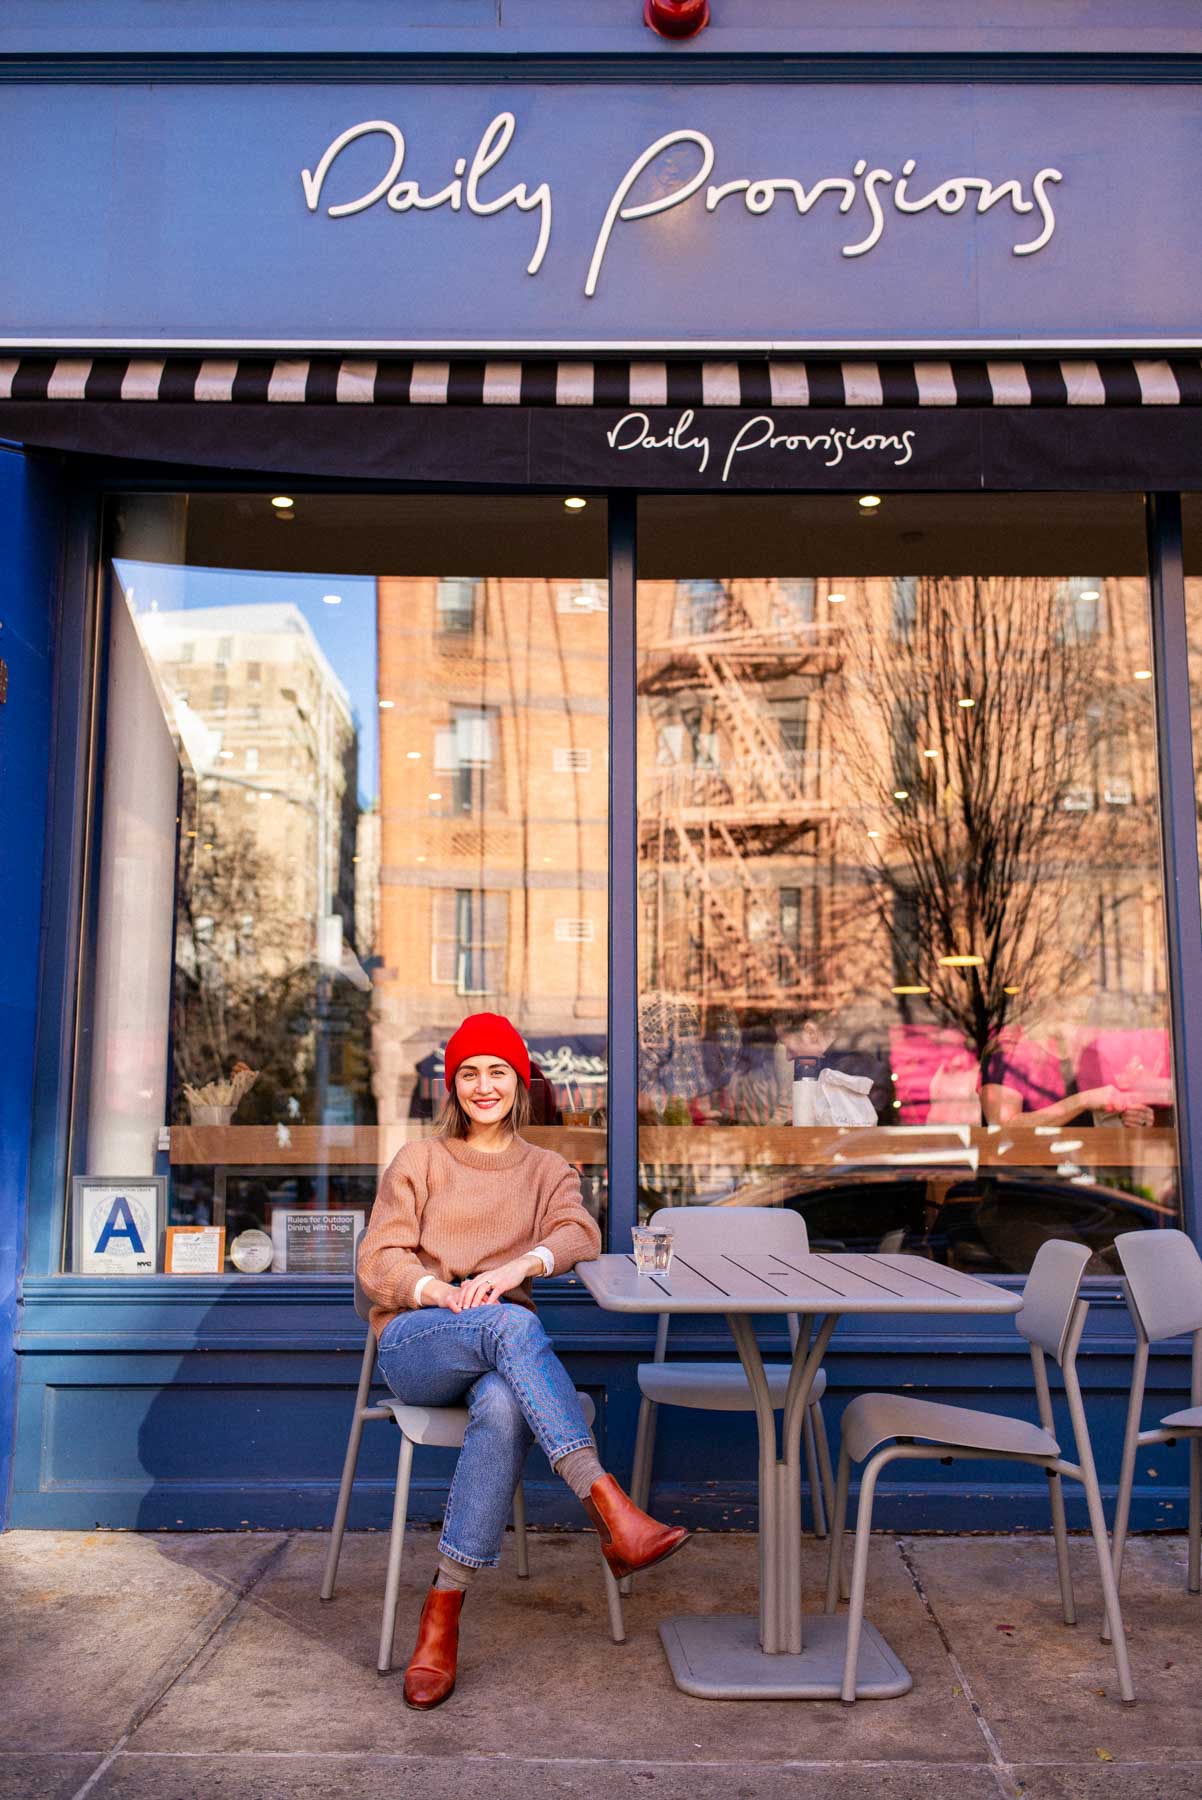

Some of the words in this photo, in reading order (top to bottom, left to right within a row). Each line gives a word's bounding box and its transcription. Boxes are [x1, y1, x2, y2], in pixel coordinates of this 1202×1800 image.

[301, 112, 553, 275] Daily
[585, 130, 1063, 296] Provisions
[606, 409, 709, 473] Daily
[722, 415, 916, 481] Provisions
[95, 1197, 145, 1253] A
[287, 1224, 311, 1232] Dining
[331, 1224, 350, 1232] Dogs
